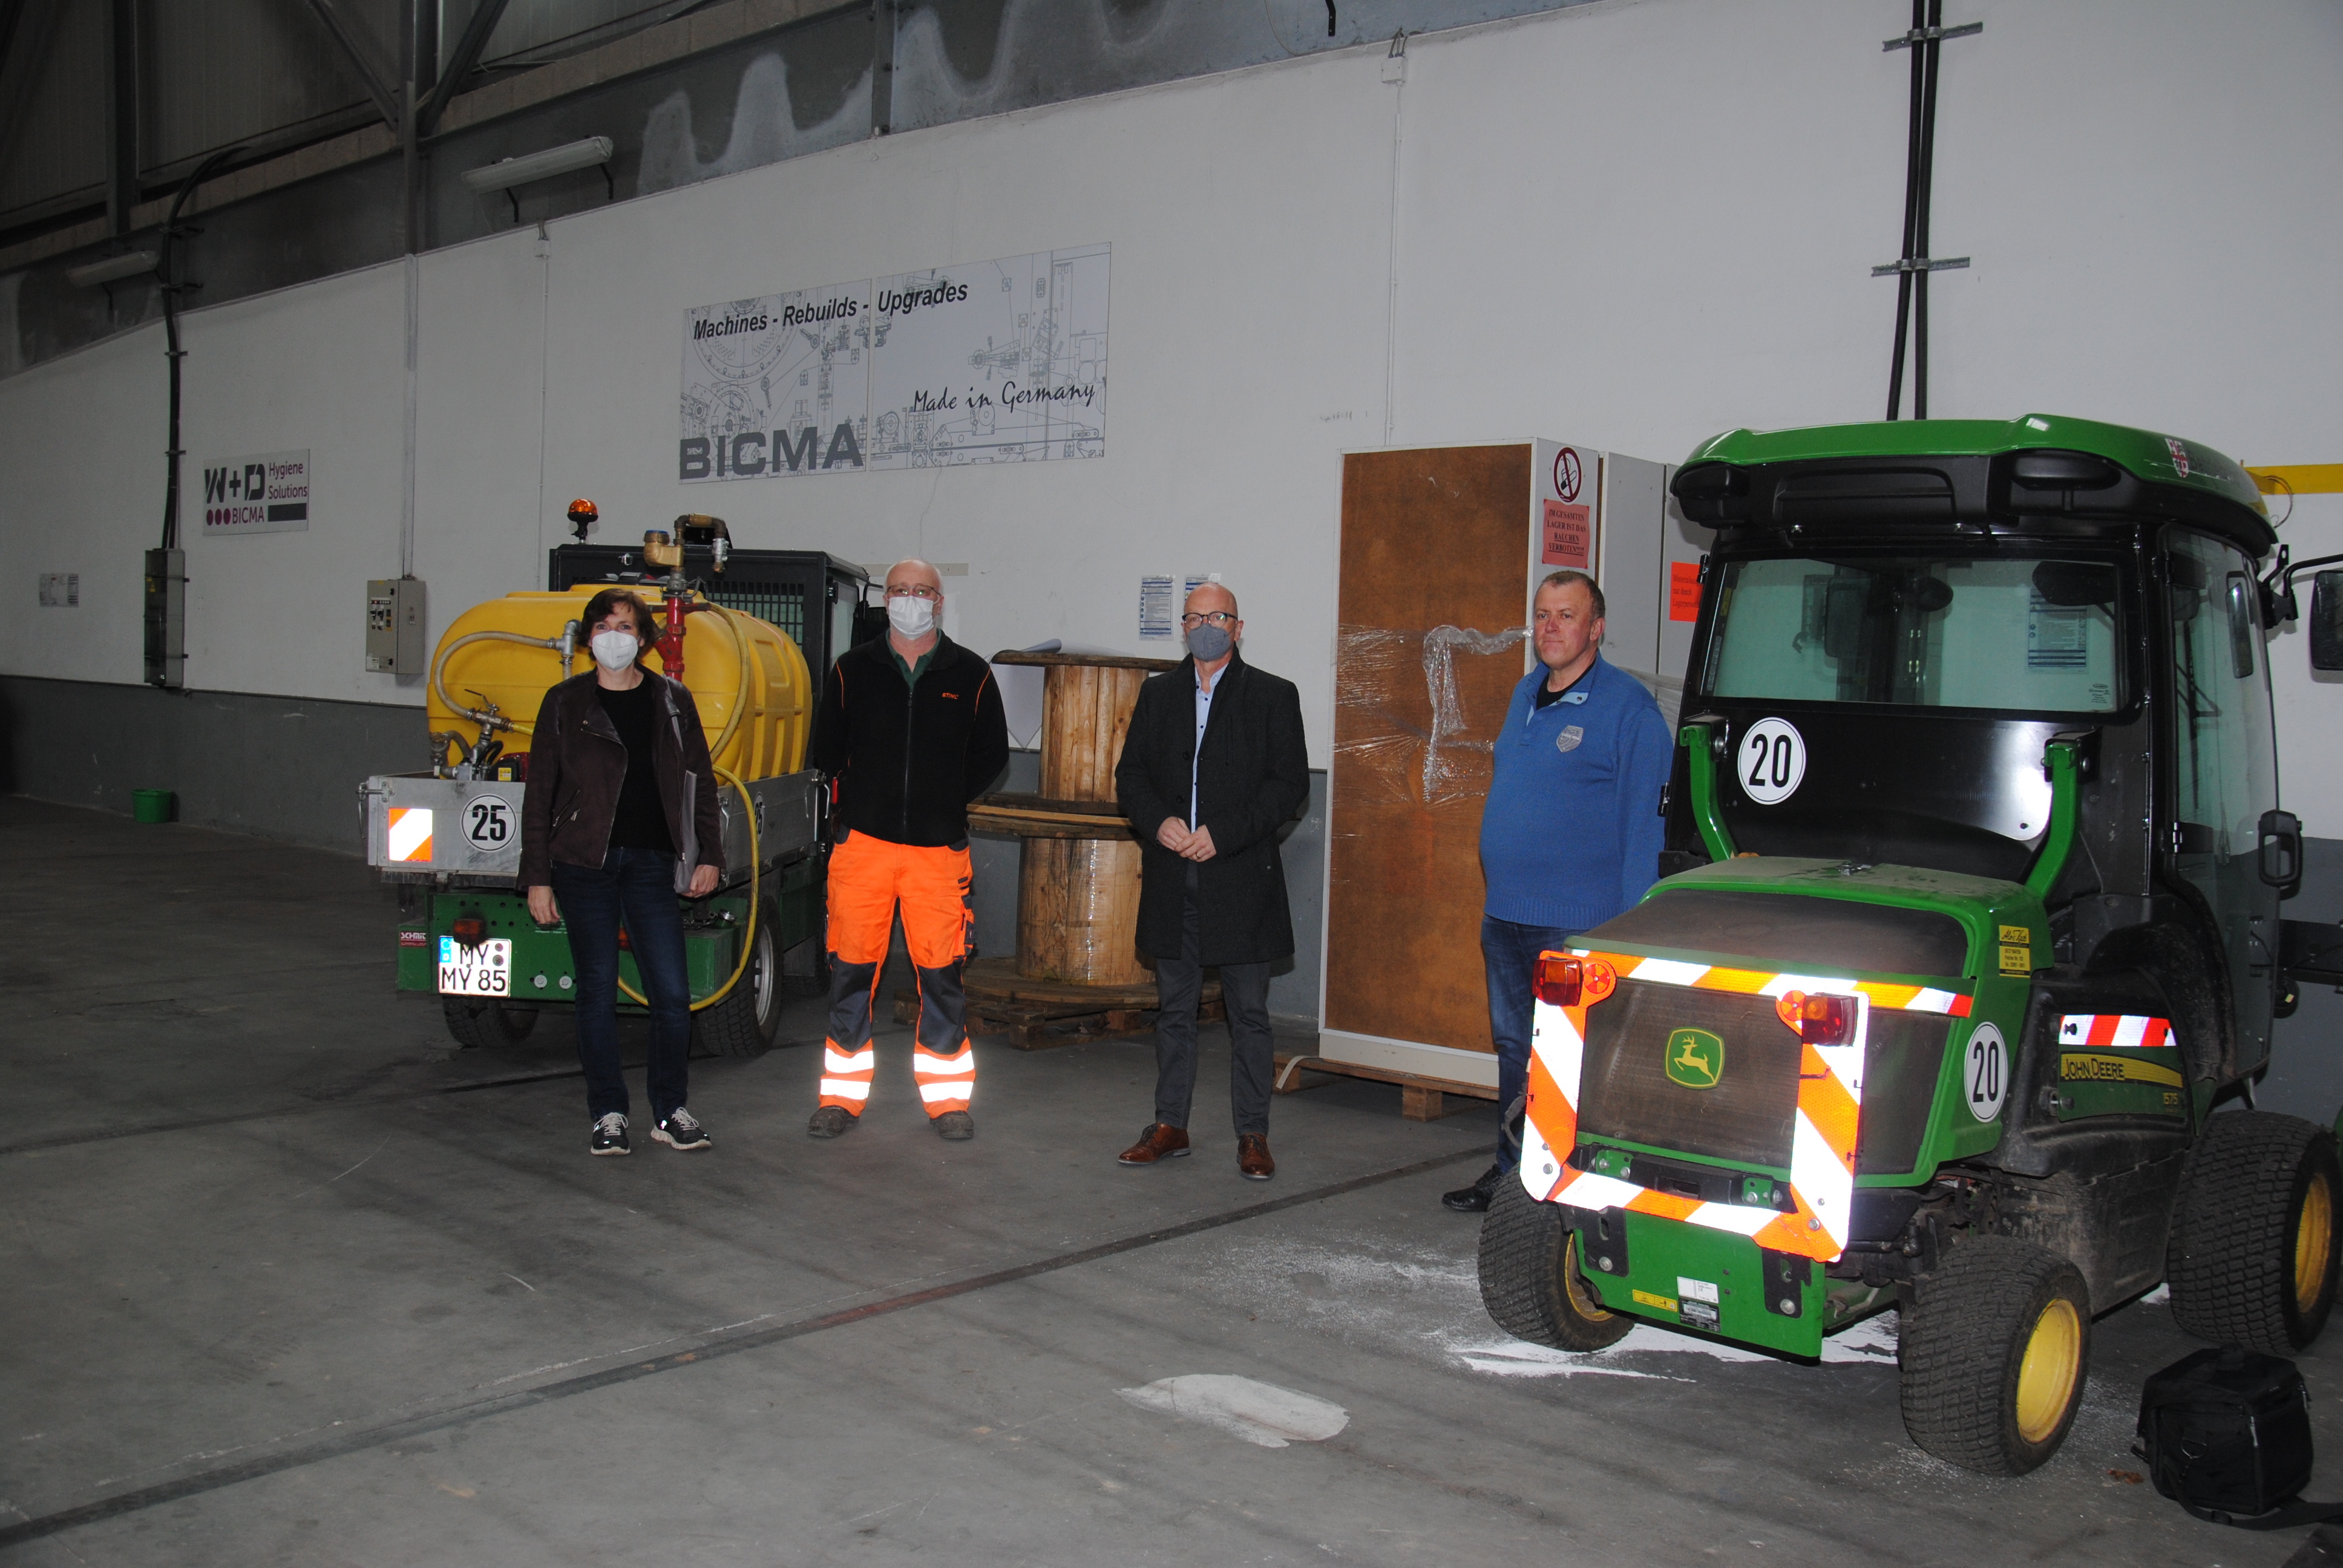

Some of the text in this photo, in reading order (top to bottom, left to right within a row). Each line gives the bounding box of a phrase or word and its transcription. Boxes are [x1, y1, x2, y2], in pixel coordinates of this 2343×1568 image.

[693, 312, 767, 341] Machines
[782, 296, 857, 327] Rebuilds
[877, 282, 968, 316] Upgrades
[913, 381, 1095, 413] Made in Germany
[680, 423, 863, 480] BICMA
[269, 461, 303, 480] Hygiene
[268, 484, 307, 500] Solutions
[232, 506, 264, 524] BICMA
[1547, 520, 1586, 533] LAGER IST DAS
[1549, 509, 1584, 521] IM GESAMTEN
[1554, 532, 1579, 543] RAUCHEN
[1749, 733, 1792, 788] 20
[472, 804, 506, 841] 25
[460, 942, 489, 965] MY
[442, 967, 506, 992] MY 85
[1973, 1040, 1999, 1102] 20
[2065, 1057, 2125, 1078] JOHN DEERE
